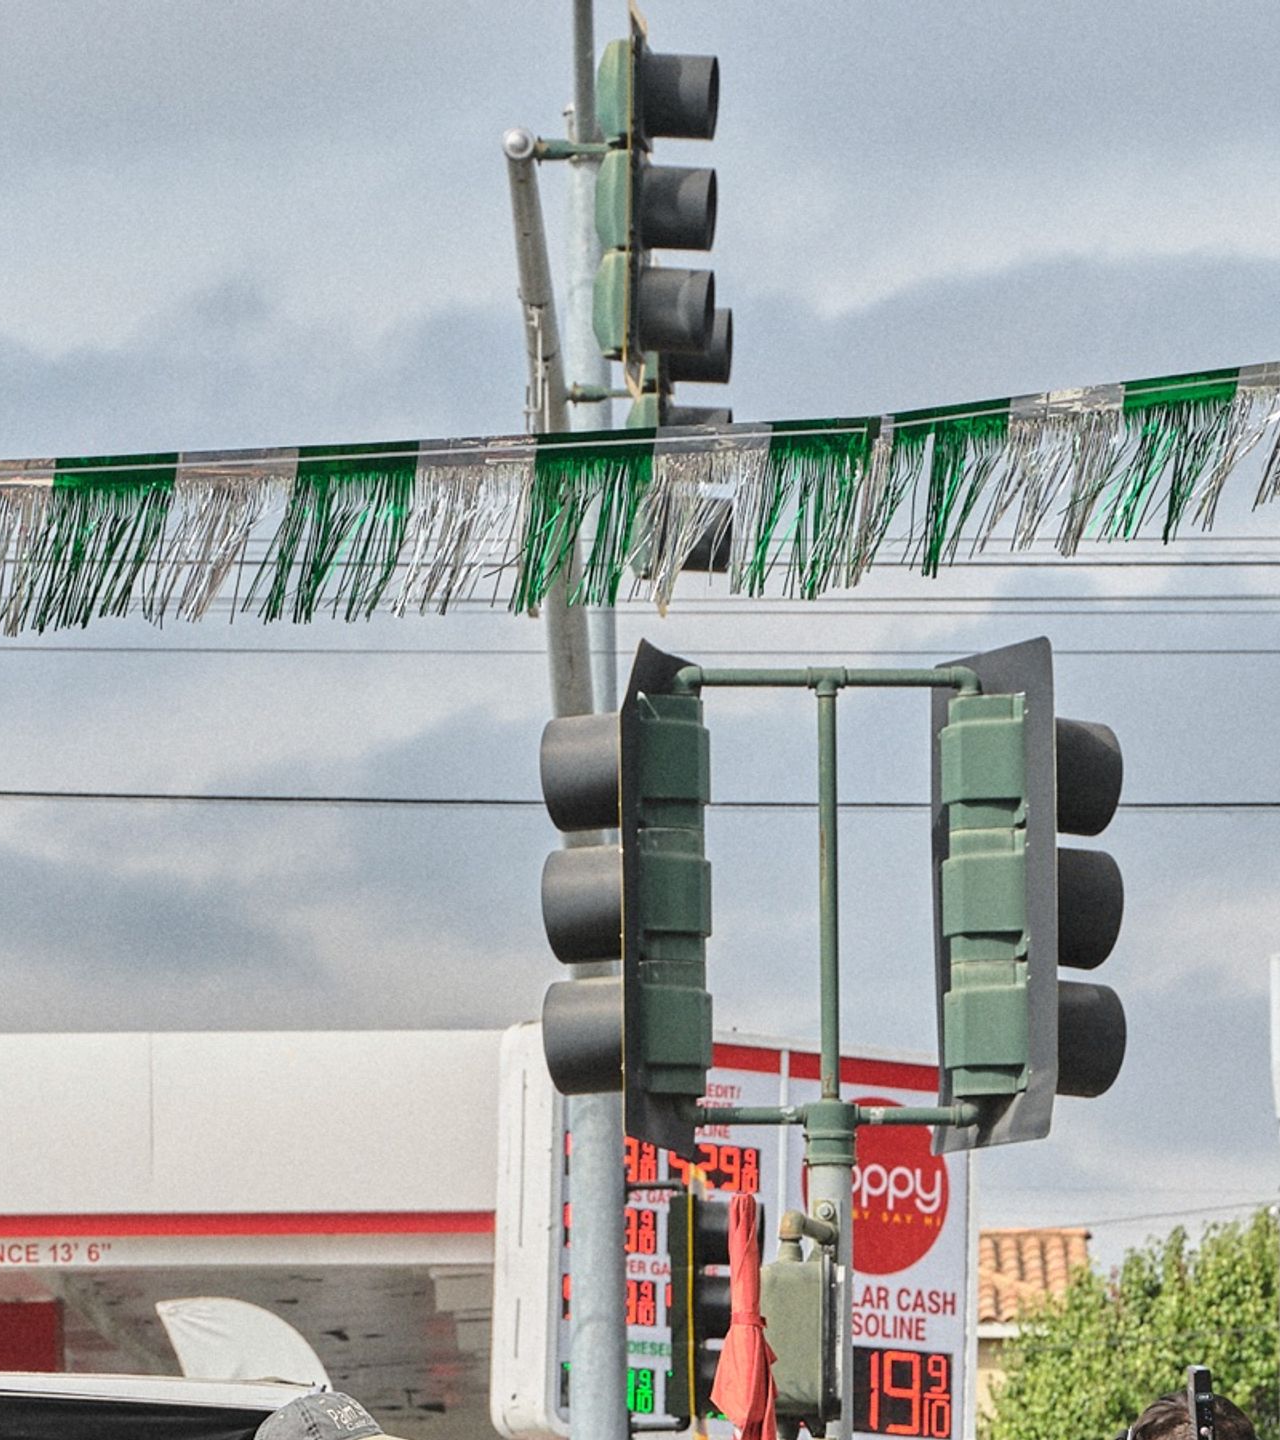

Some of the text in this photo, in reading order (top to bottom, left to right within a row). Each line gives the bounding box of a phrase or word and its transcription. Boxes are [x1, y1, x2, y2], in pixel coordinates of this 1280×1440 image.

[707, 1083, 741, 1099] EDIT/
[49, 1242, 80, 1263] 13'
[896, 1288, 957, 1316] CASH
[852, 1312, 927, 1342] SOLINE
